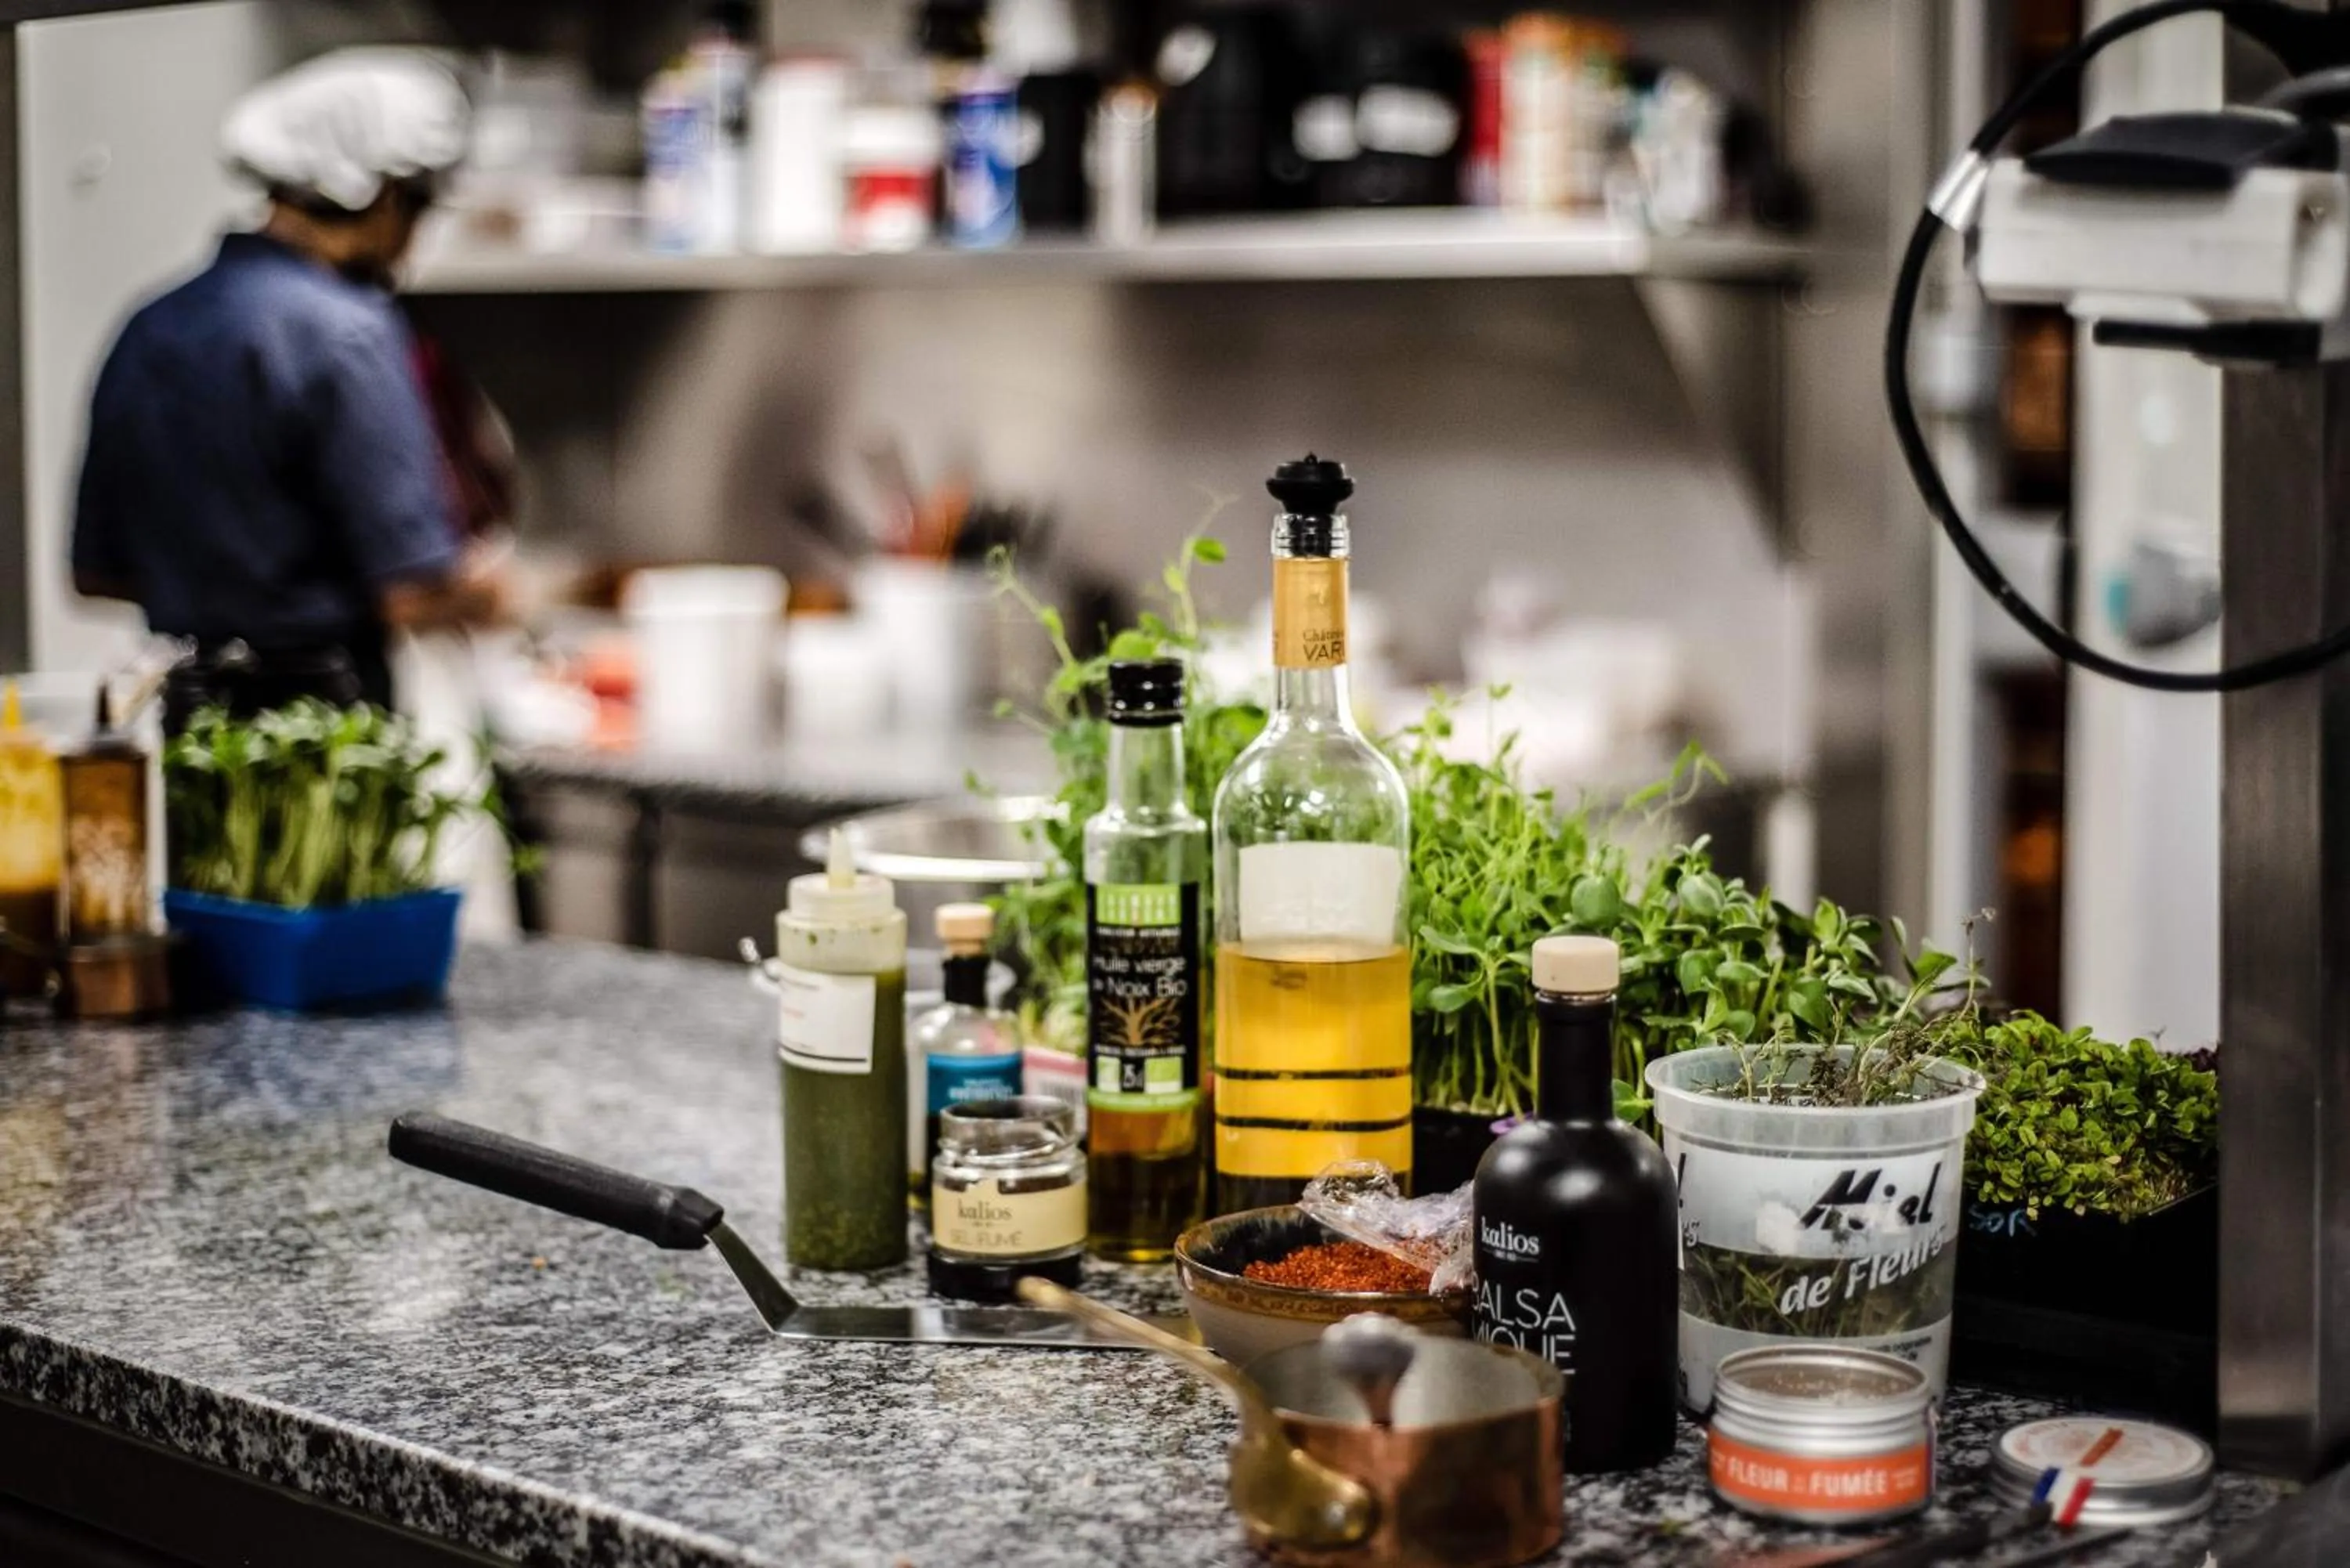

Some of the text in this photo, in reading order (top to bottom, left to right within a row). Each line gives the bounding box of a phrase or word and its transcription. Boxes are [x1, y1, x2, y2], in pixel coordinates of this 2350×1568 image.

[1157, 977, 1187, 998] Bio
[958, 1199, 1013, 1221] kalios
[1481, 1216, 1540, 1255] kalios
[1780, 1226, 1947, 1315] de Fleurs
[1727, 1457, 1789, 1491] FLEUR
[1809, 1467, 1888, 1498] FUMÉE
